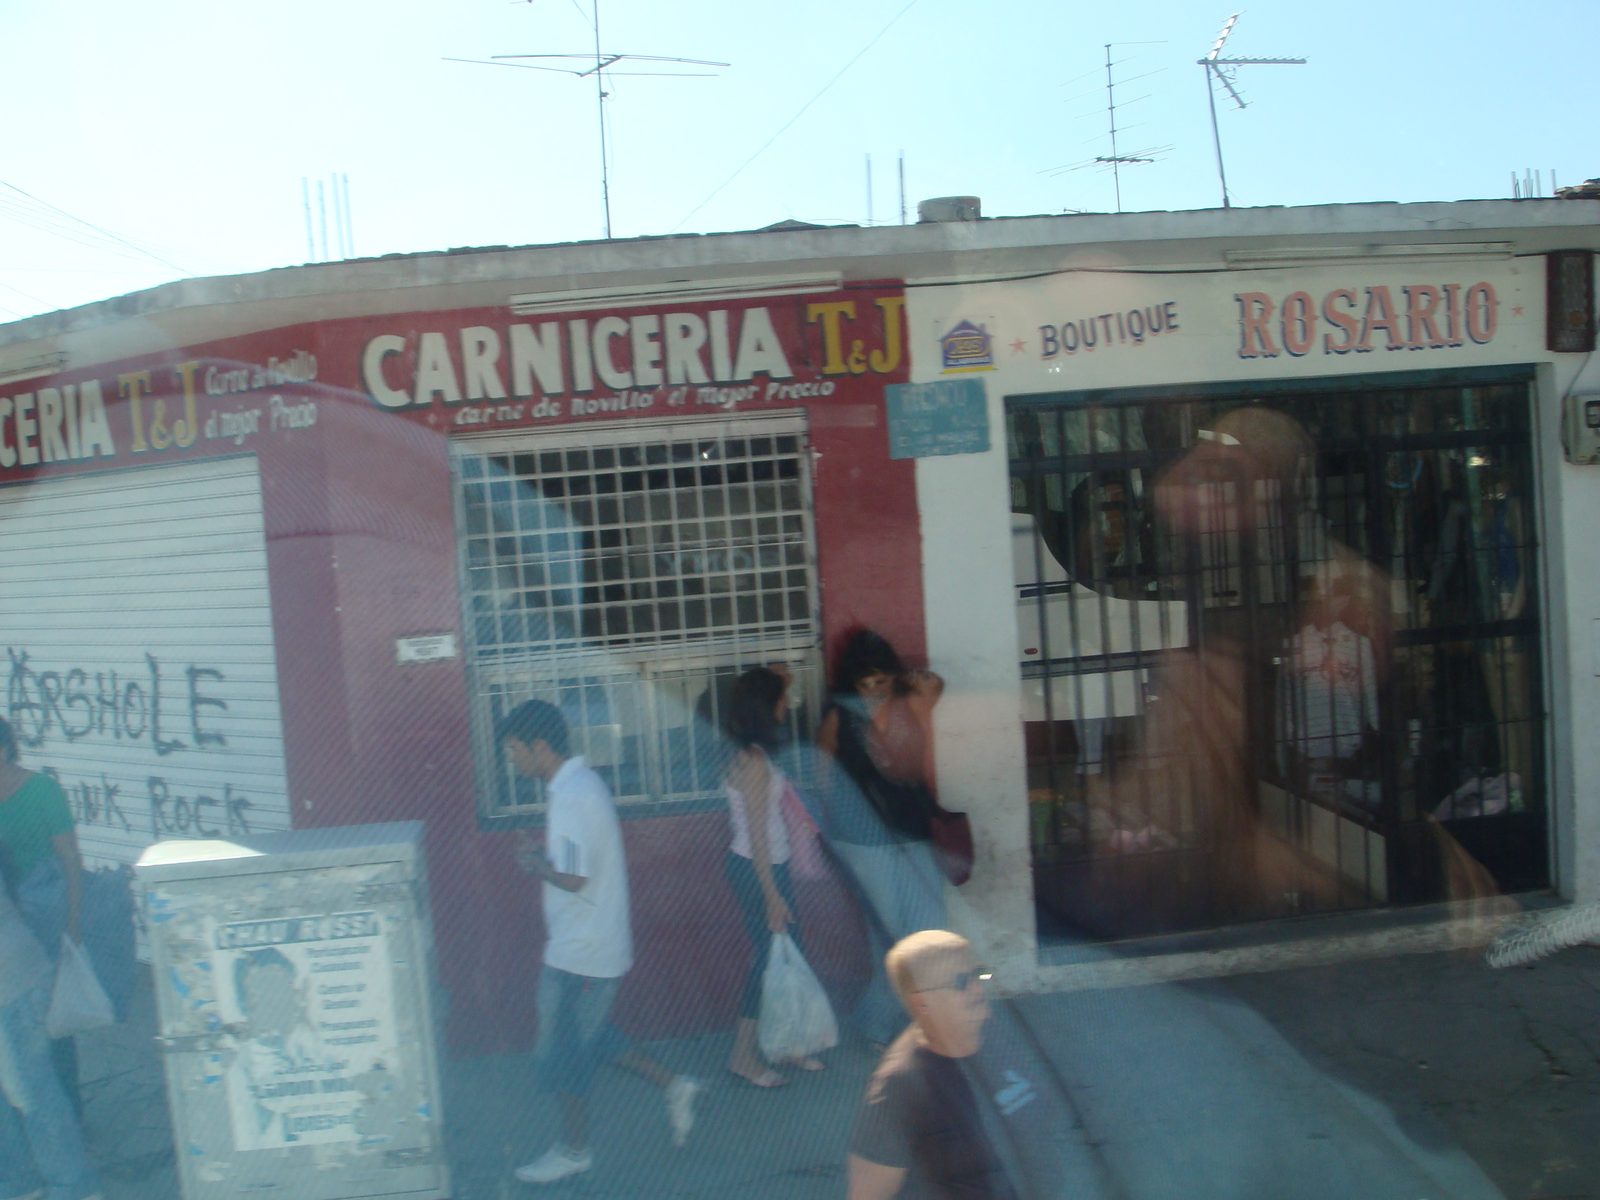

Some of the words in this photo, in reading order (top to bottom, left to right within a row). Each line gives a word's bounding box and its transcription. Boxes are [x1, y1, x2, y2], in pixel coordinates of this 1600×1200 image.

[362, 307, 794, 408] CARNICERIA
[1039, 301, 1180, 360] BOUTIQUE
[1234, 281, 1500, 359] ROSARIO
